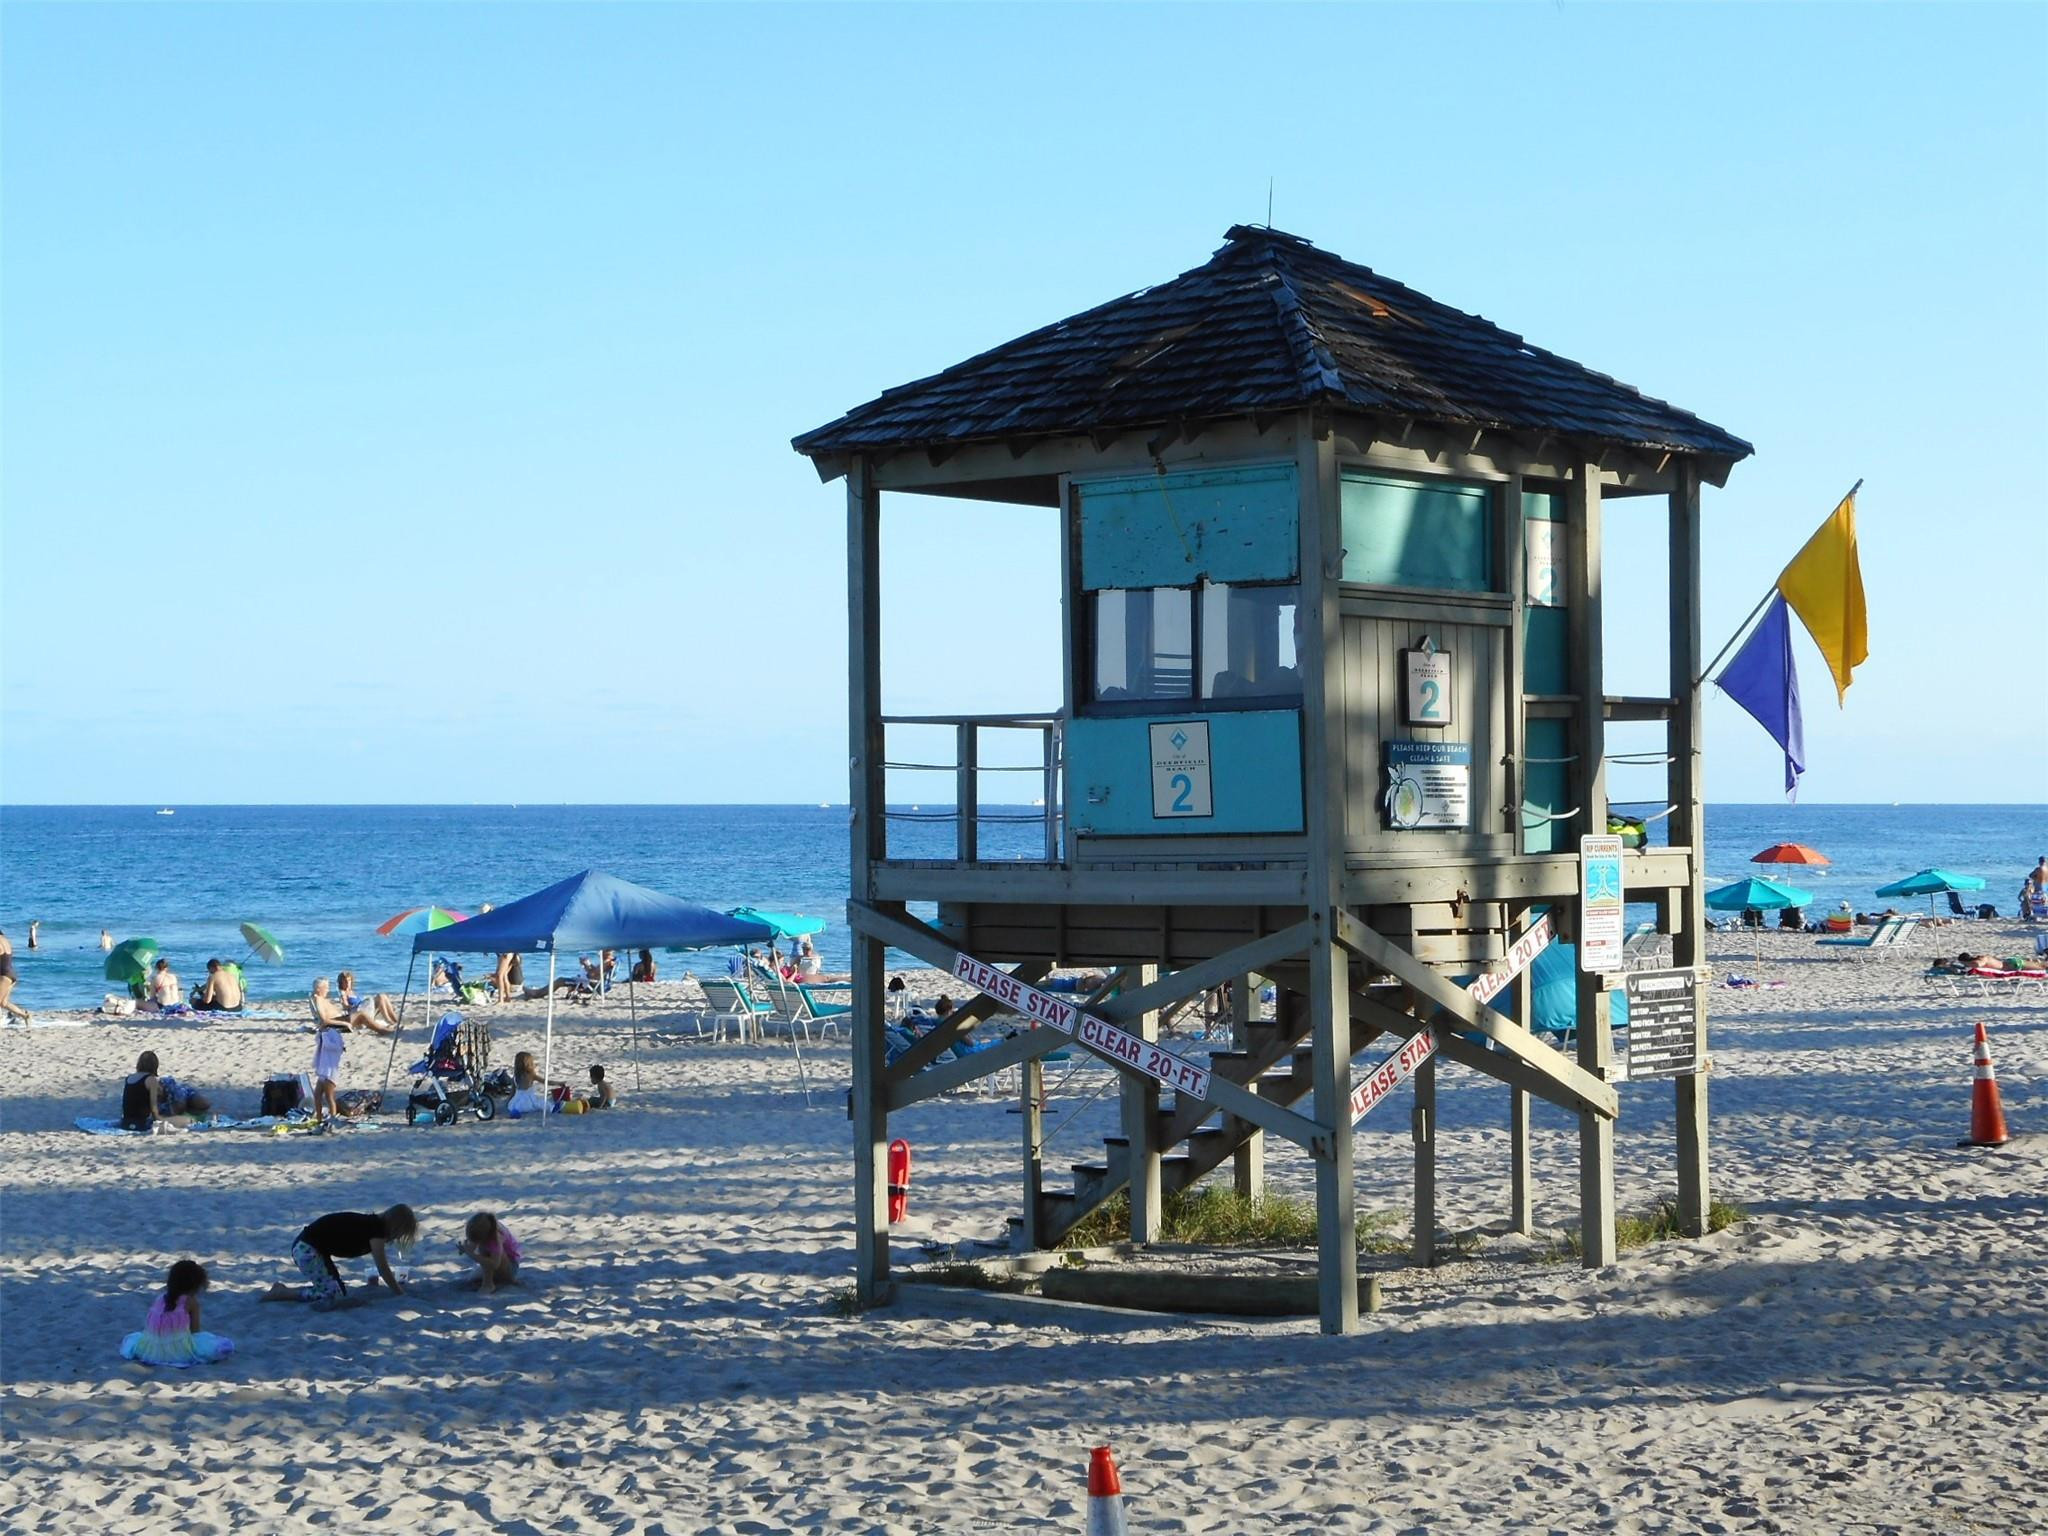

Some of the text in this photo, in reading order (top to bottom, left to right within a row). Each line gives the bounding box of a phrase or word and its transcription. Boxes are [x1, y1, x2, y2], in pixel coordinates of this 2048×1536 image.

[1539, 567, 1558, 603] 2
[1420, 680, 1440, 718] 2
[1432, 744, 1446, 752] OUR
[1170, 774, 1193, 812] 2
[1594, 844, 1618, 852] CURRENTS
[1515, 938, 1532, 966] 20
[957, 958, 1071, 1027] PLEASE STAY
[1083, 1020, 1202, 1094] CLEAR 20 FT.
[1400, 1029, 1434, 1072] STAY
